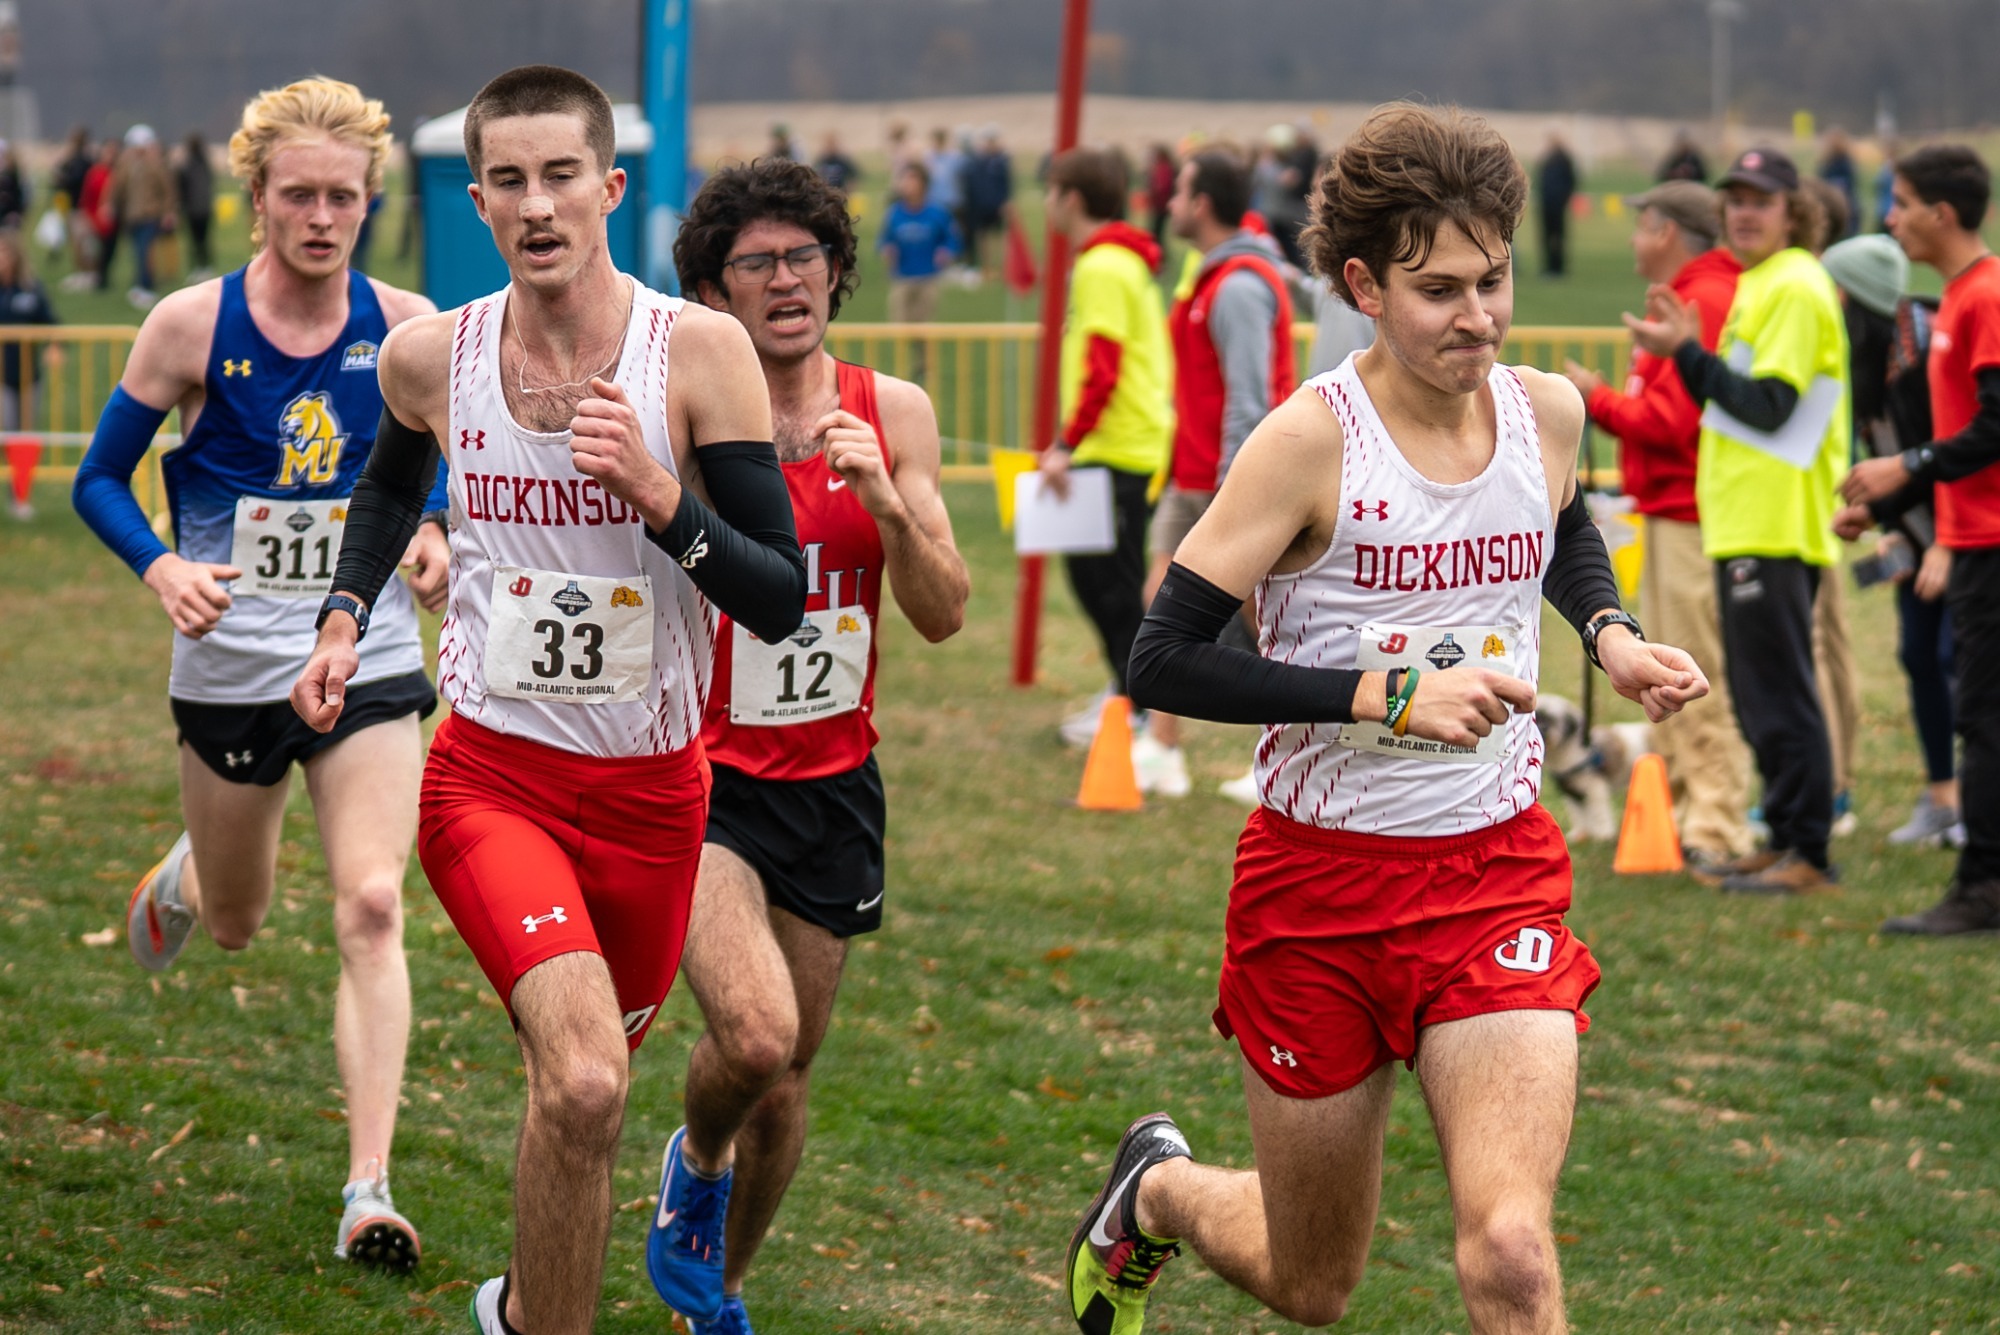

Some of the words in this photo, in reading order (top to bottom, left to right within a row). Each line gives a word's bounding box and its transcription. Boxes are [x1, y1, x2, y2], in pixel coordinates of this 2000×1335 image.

[345, 355, 375, 367] MAC
[256, 535, 332, 580] 311
[1353, 530, 1544, 592] DICKINSON
[531, 618, 604, 681] 33
[516, 681, 574, 695] MID-ATLANTIC
[576, 686, 616, 695] REGIONAL
[776, 651, 833, 703] 12
[761, 703, 809, 717] MID-ATLANTIC
[1377, 735, 1438, 753] MID-ATLANTIC
